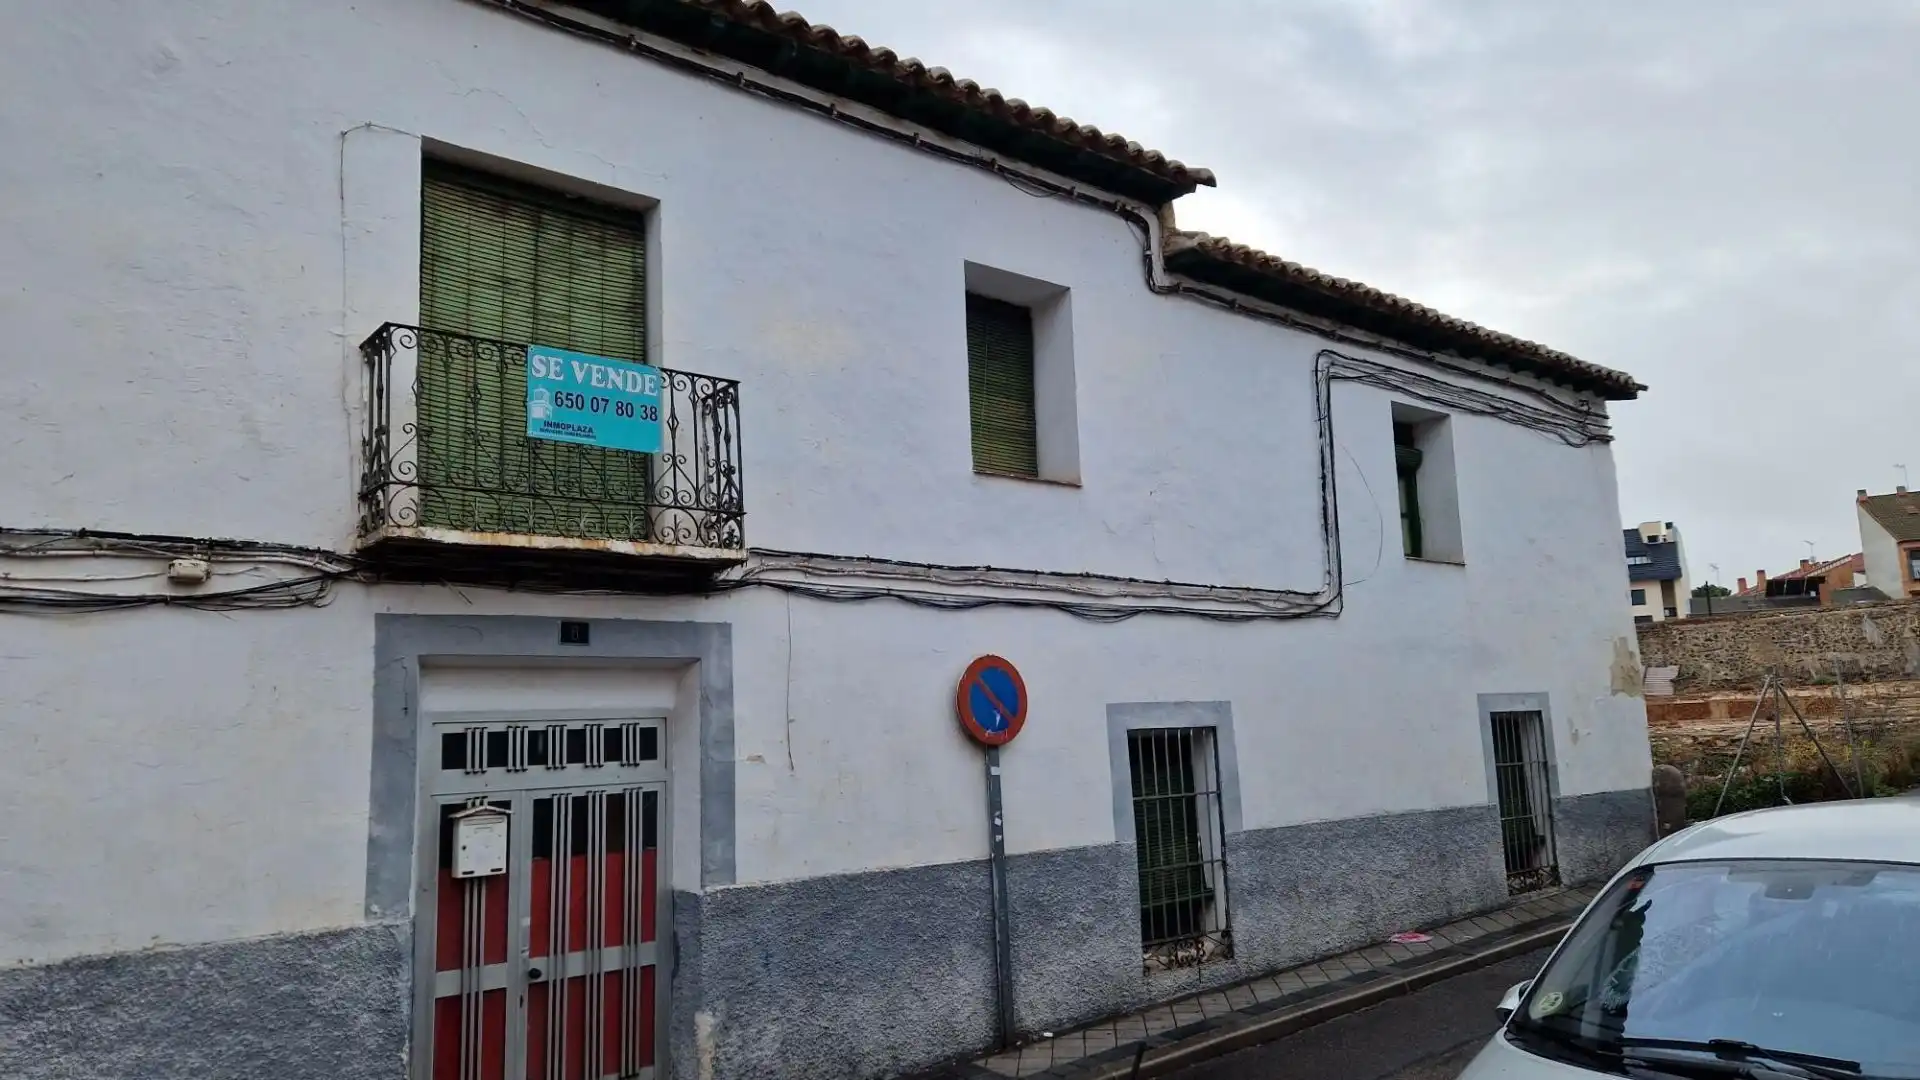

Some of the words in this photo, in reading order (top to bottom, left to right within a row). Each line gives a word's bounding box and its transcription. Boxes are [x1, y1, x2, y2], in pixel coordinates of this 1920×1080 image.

[531, 354, 564, 380] SE
[571, 360, 658, 396] VENDE
[554, 390, 585, 411] 650
[590, 396, 610, 414] 07
[615, 400, 634, 418] 80
[640, 404, 658, 422] 38
[543, 420, 594, 434] INMOPLAZA
